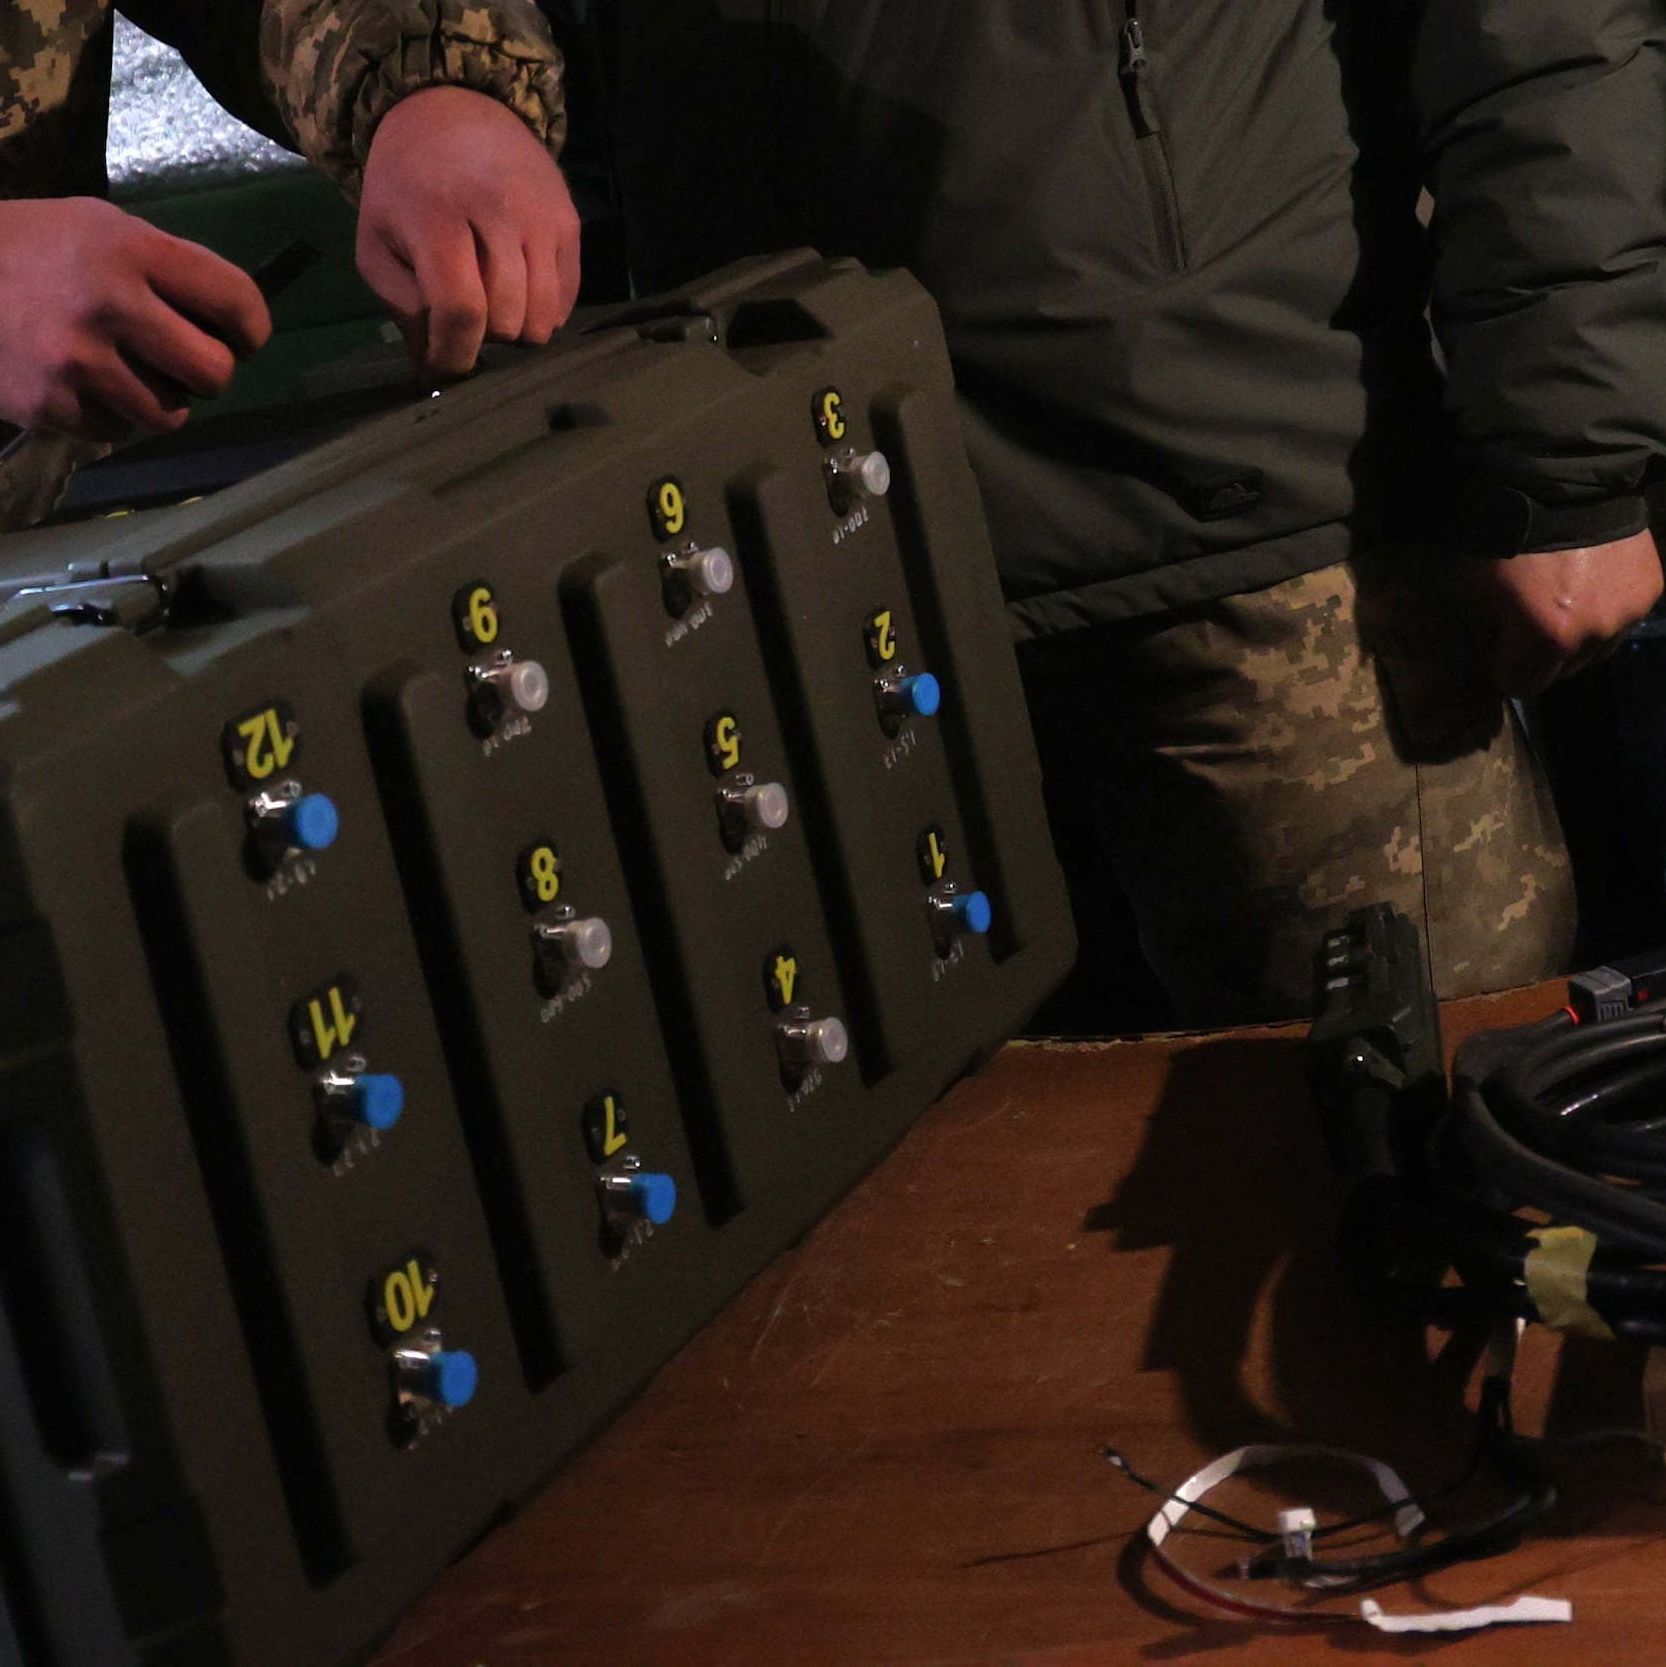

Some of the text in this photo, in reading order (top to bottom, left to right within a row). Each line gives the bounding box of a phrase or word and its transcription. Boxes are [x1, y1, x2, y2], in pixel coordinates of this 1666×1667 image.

[823, 393, 845, 438] 3
[874, 612, 895, 660] 2
[238, 708, 293, 779] 12
[717, 717, 739, 768] 5
[531, 846, 559, 901] 8
[927, 832, 945, 877] 1
[775, 958, 797, 1003] 4
[310, 986, 355, 1057] 11
[604, 1096, 626, 1154] 7
[385, 1259, 433, 1331] 10
